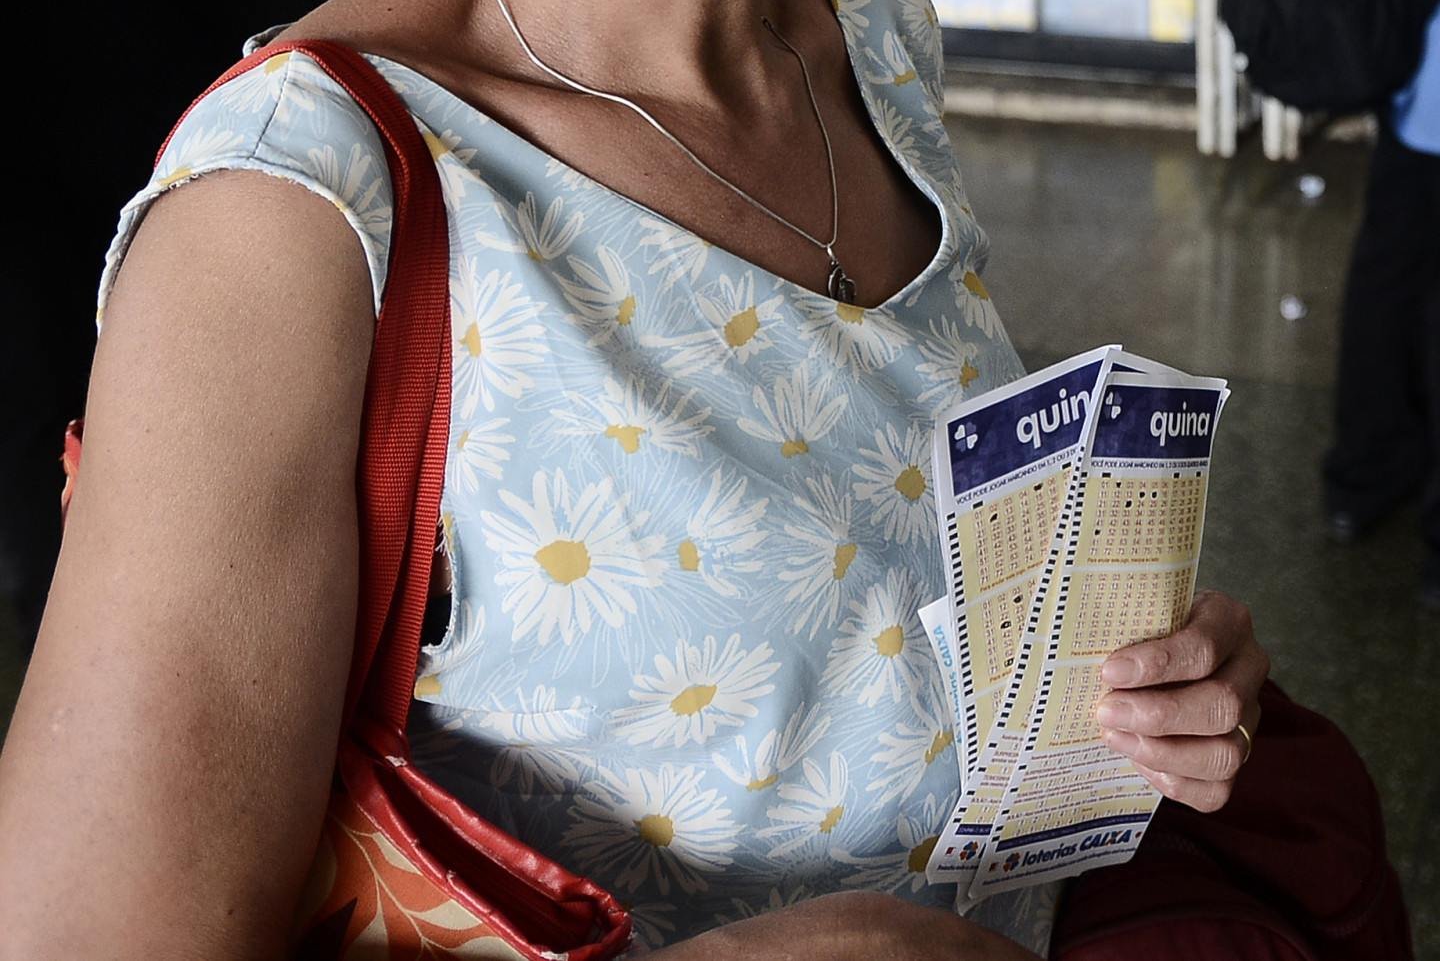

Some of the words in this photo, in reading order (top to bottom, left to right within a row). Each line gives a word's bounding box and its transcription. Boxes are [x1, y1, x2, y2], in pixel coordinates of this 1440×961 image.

[1150, 401, 1210, 446] quina
[933, 624, 953, 668] CAIXA
[1022, 843, 1077, 867] loterias
[1079, 829, 1133, 851] CAIXA
